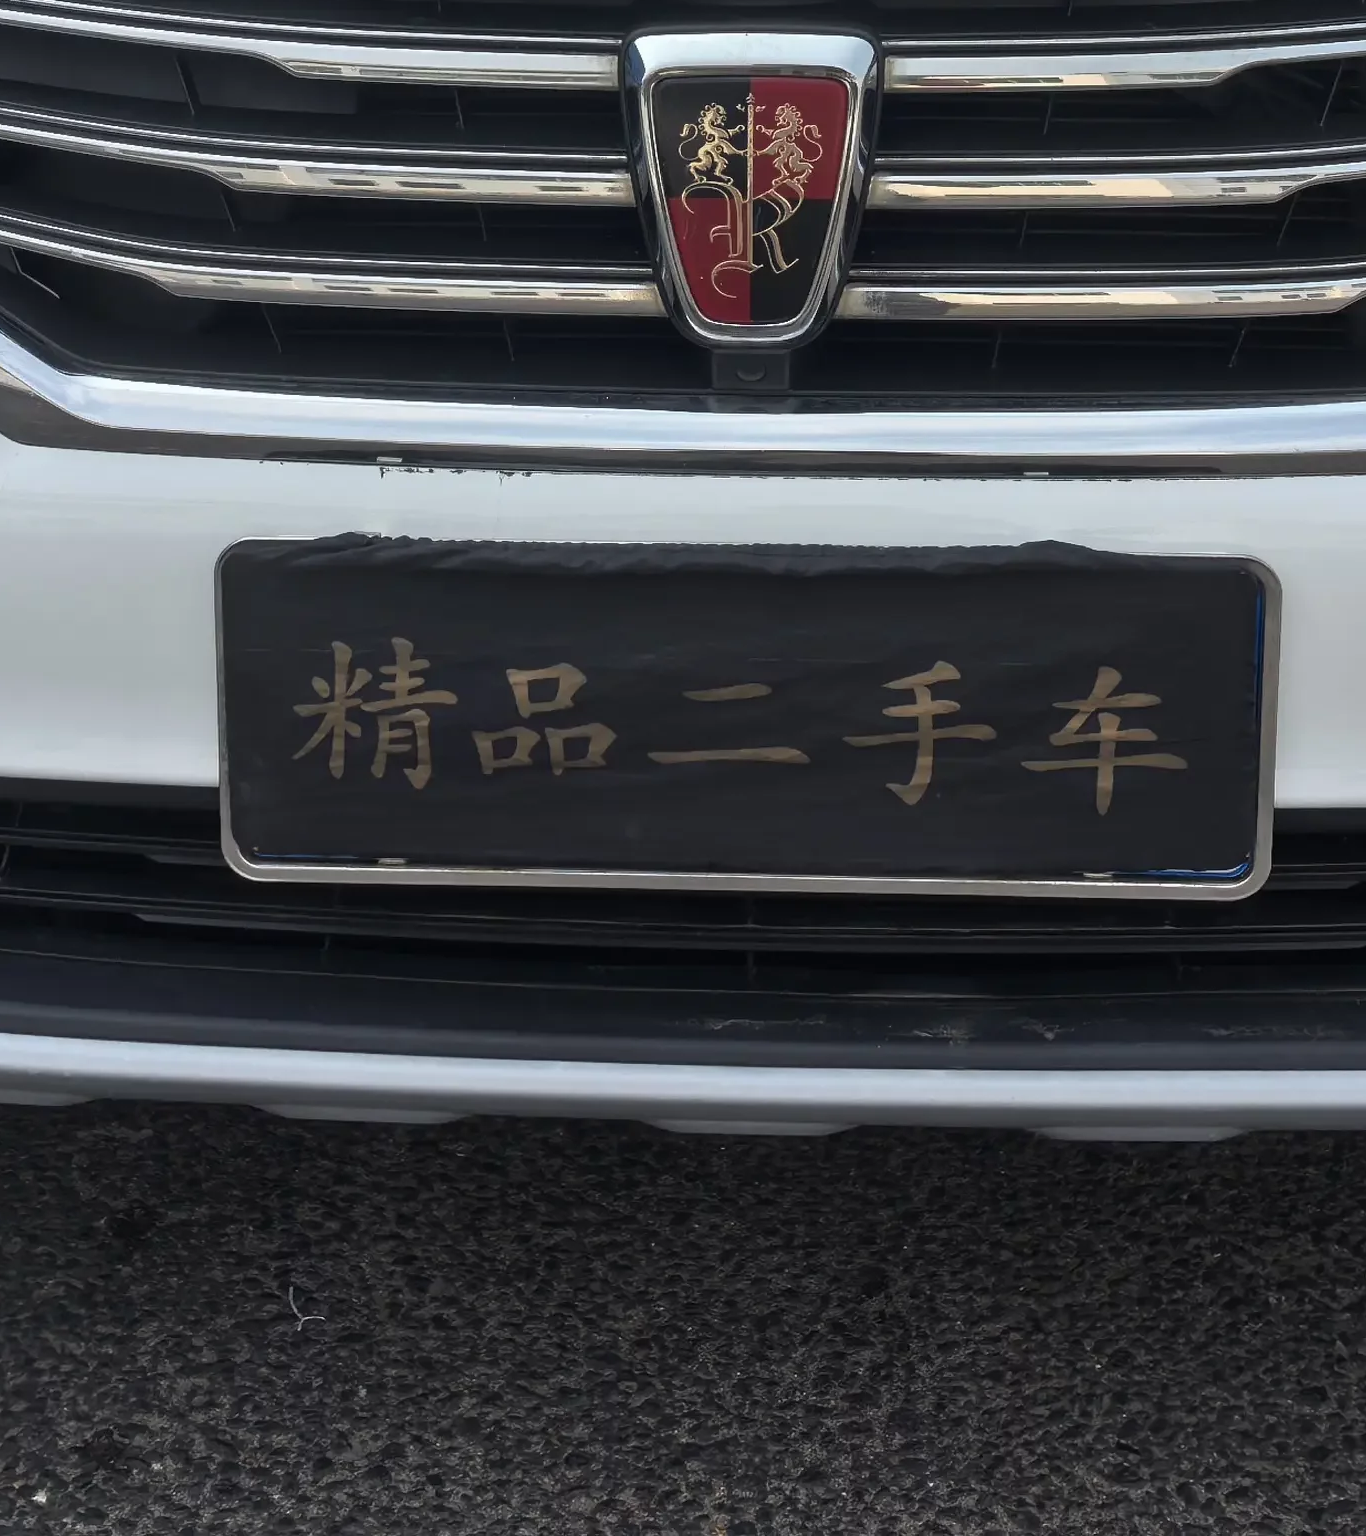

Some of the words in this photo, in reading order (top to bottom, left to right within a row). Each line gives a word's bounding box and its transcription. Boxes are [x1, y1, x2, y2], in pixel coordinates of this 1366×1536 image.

[291, 636, 1188, 816] 精品二手车
